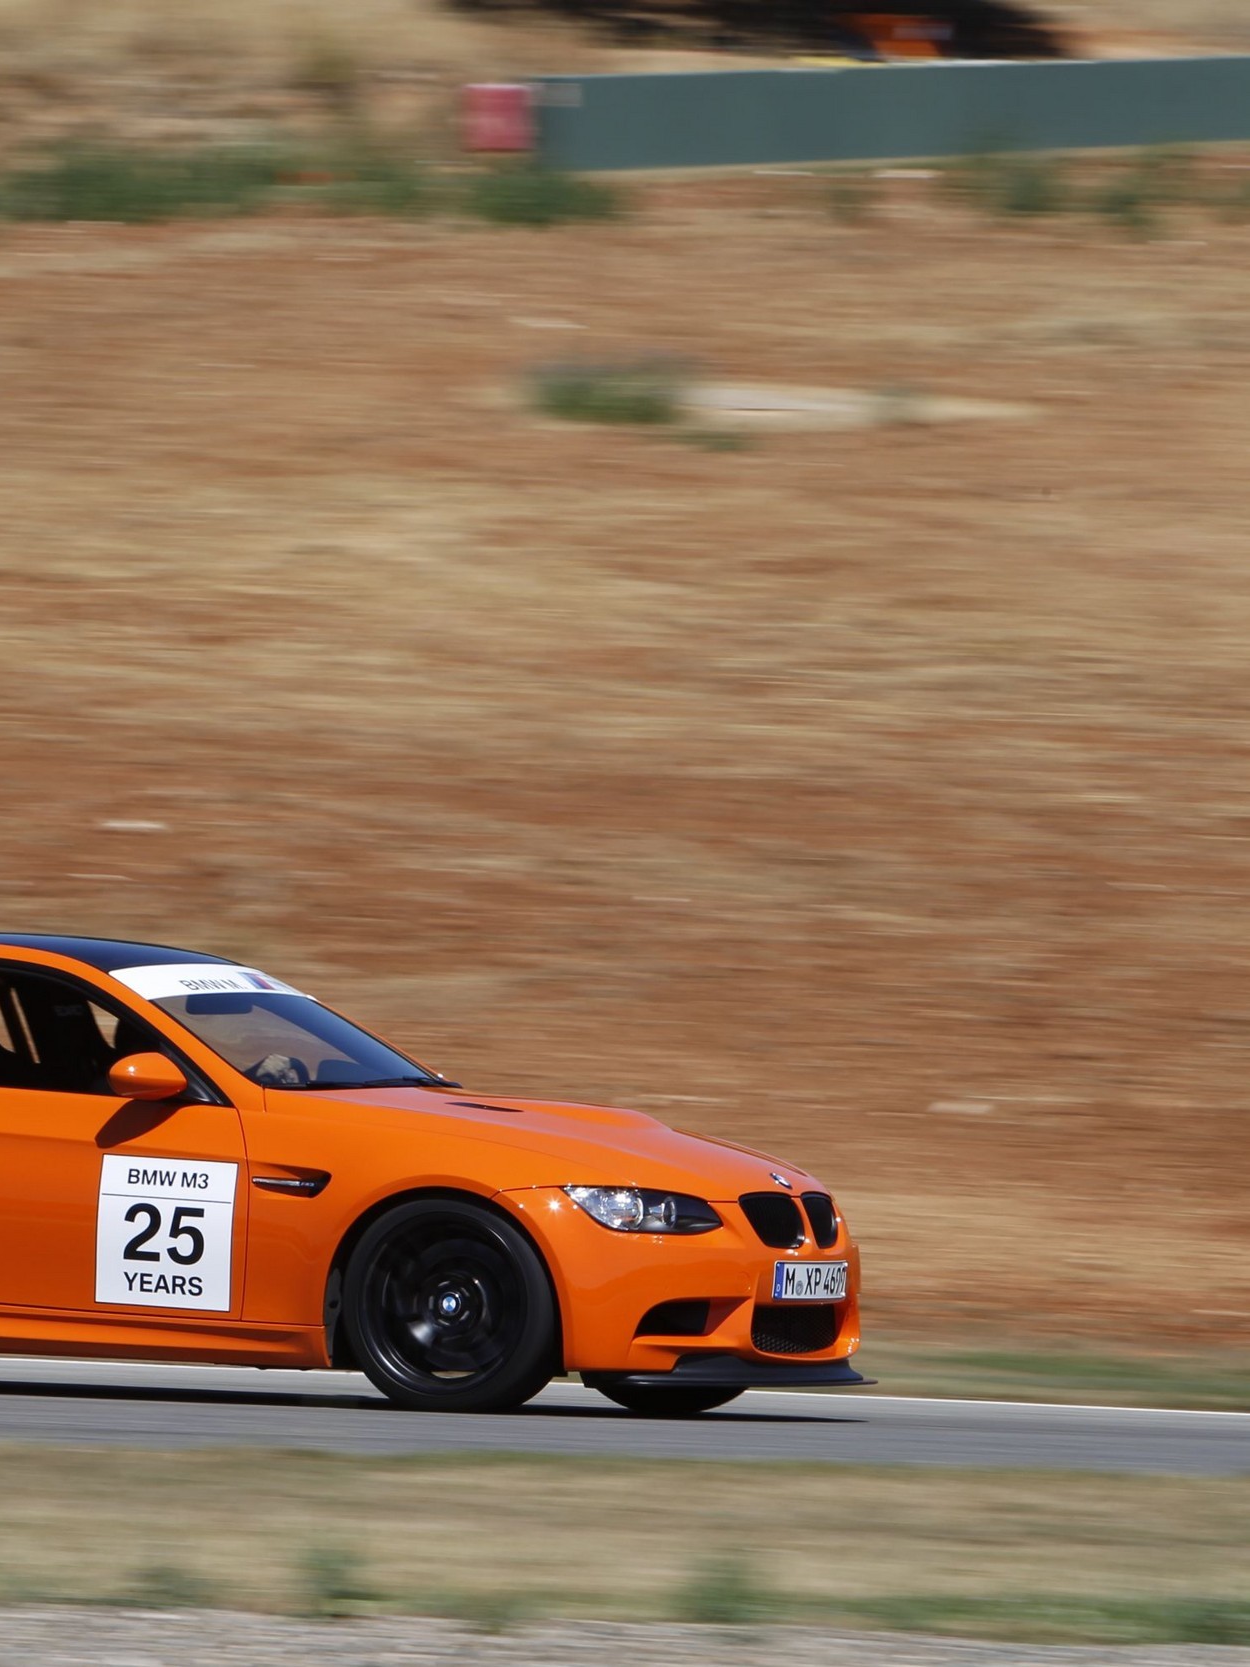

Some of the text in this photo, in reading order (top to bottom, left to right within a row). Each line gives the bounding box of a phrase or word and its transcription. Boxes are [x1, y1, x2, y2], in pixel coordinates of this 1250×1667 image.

[179, 979, 227, 991] BMW
[127, 1168, 209, 1189] BMW M3
[123, 1202, 205, 1265] 25
[123, 1272, 203, 1297] YEARS
[784, 1268, 796, 1295] M
[804, 1268, 822, 1295] XP
